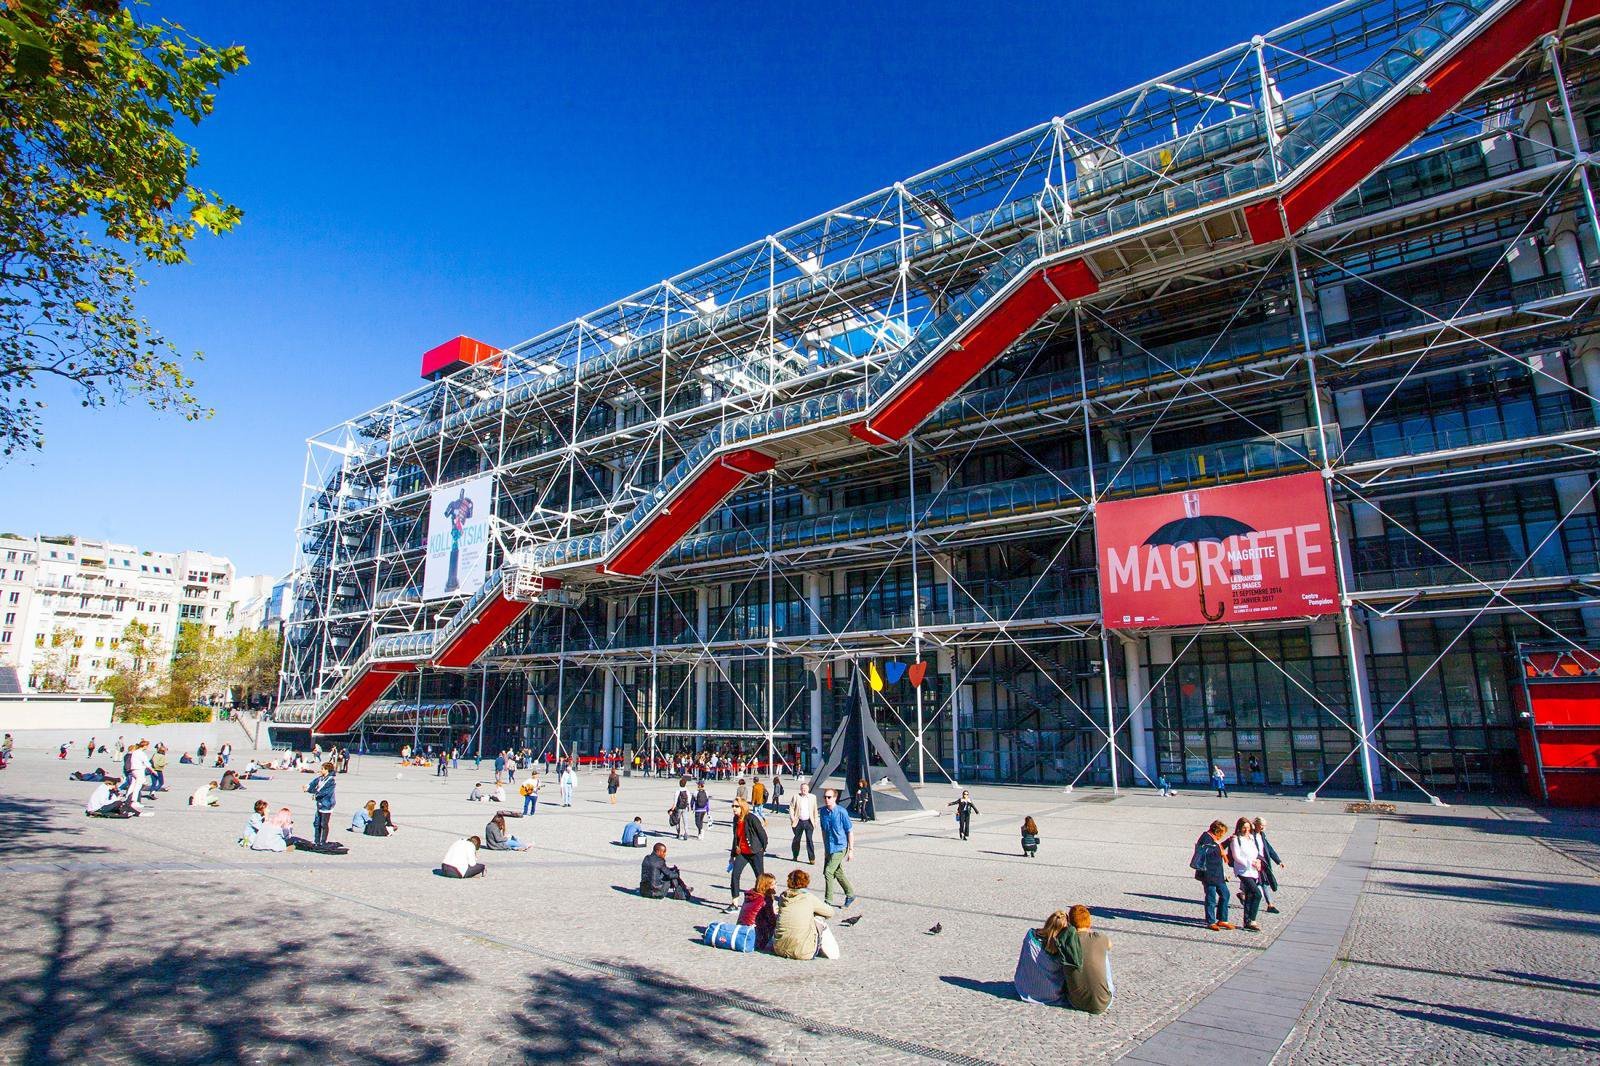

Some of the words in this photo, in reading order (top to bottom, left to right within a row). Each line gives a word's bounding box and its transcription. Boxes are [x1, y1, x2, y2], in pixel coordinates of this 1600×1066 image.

[430, 522, 487, 553] KOLLTSIA!
[1107, 523, 1326, 594] MAGRITTE
[1228, 546, 1275, 562] MAGRITTE
[1239, 588, 1269, 596] SEPTEMBRE
[1270, 587, 1282, 595] 2016
[1242, 581, 1261, 589] IMAGES
